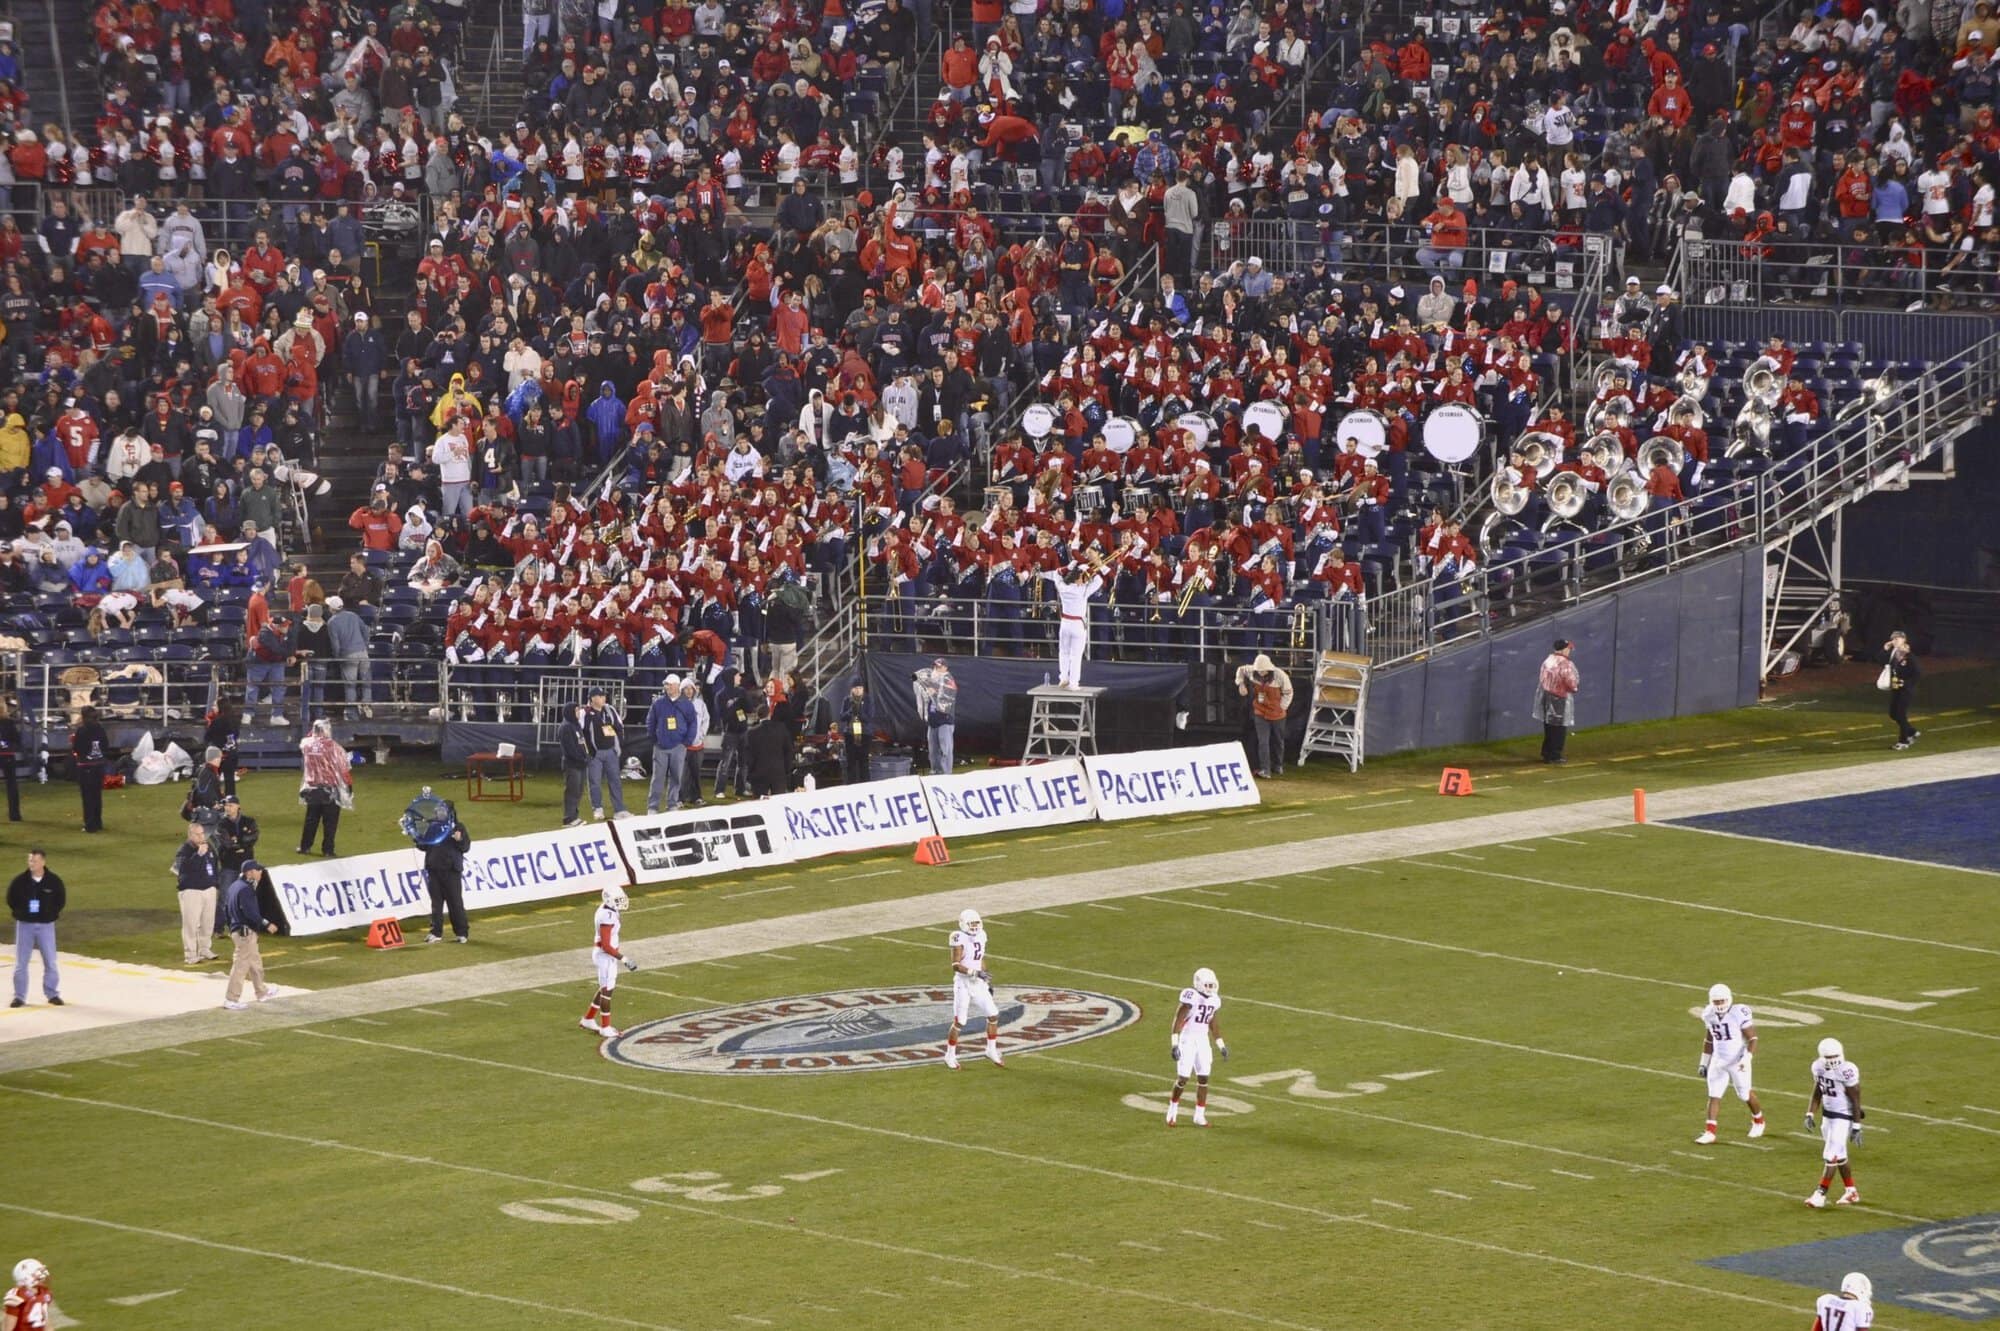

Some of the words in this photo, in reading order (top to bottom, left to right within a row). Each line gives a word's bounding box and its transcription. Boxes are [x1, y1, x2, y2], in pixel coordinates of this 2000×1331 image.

[1025, 773, 1087, 812] LIFE
[1097, 767, 1193, 806] PACIFIC
[1190, 761, 1249, 796] LIFE
[1444, 772, 1462, 794] G
[868, 791, 929, 830] LIFE
[633, 813, 773, 871] ESPN
[925, 839, 945, 862] 10
[552, 839, 617, 880] LIFE
[377, 920, 400, 945] 20
[973, 941, 982, 961] 2
[1194, 1004, 1214, 1025] 32
[1711, 1023, 1733, 1041] 51
[1824, 1306, 1847, 1331] 17
